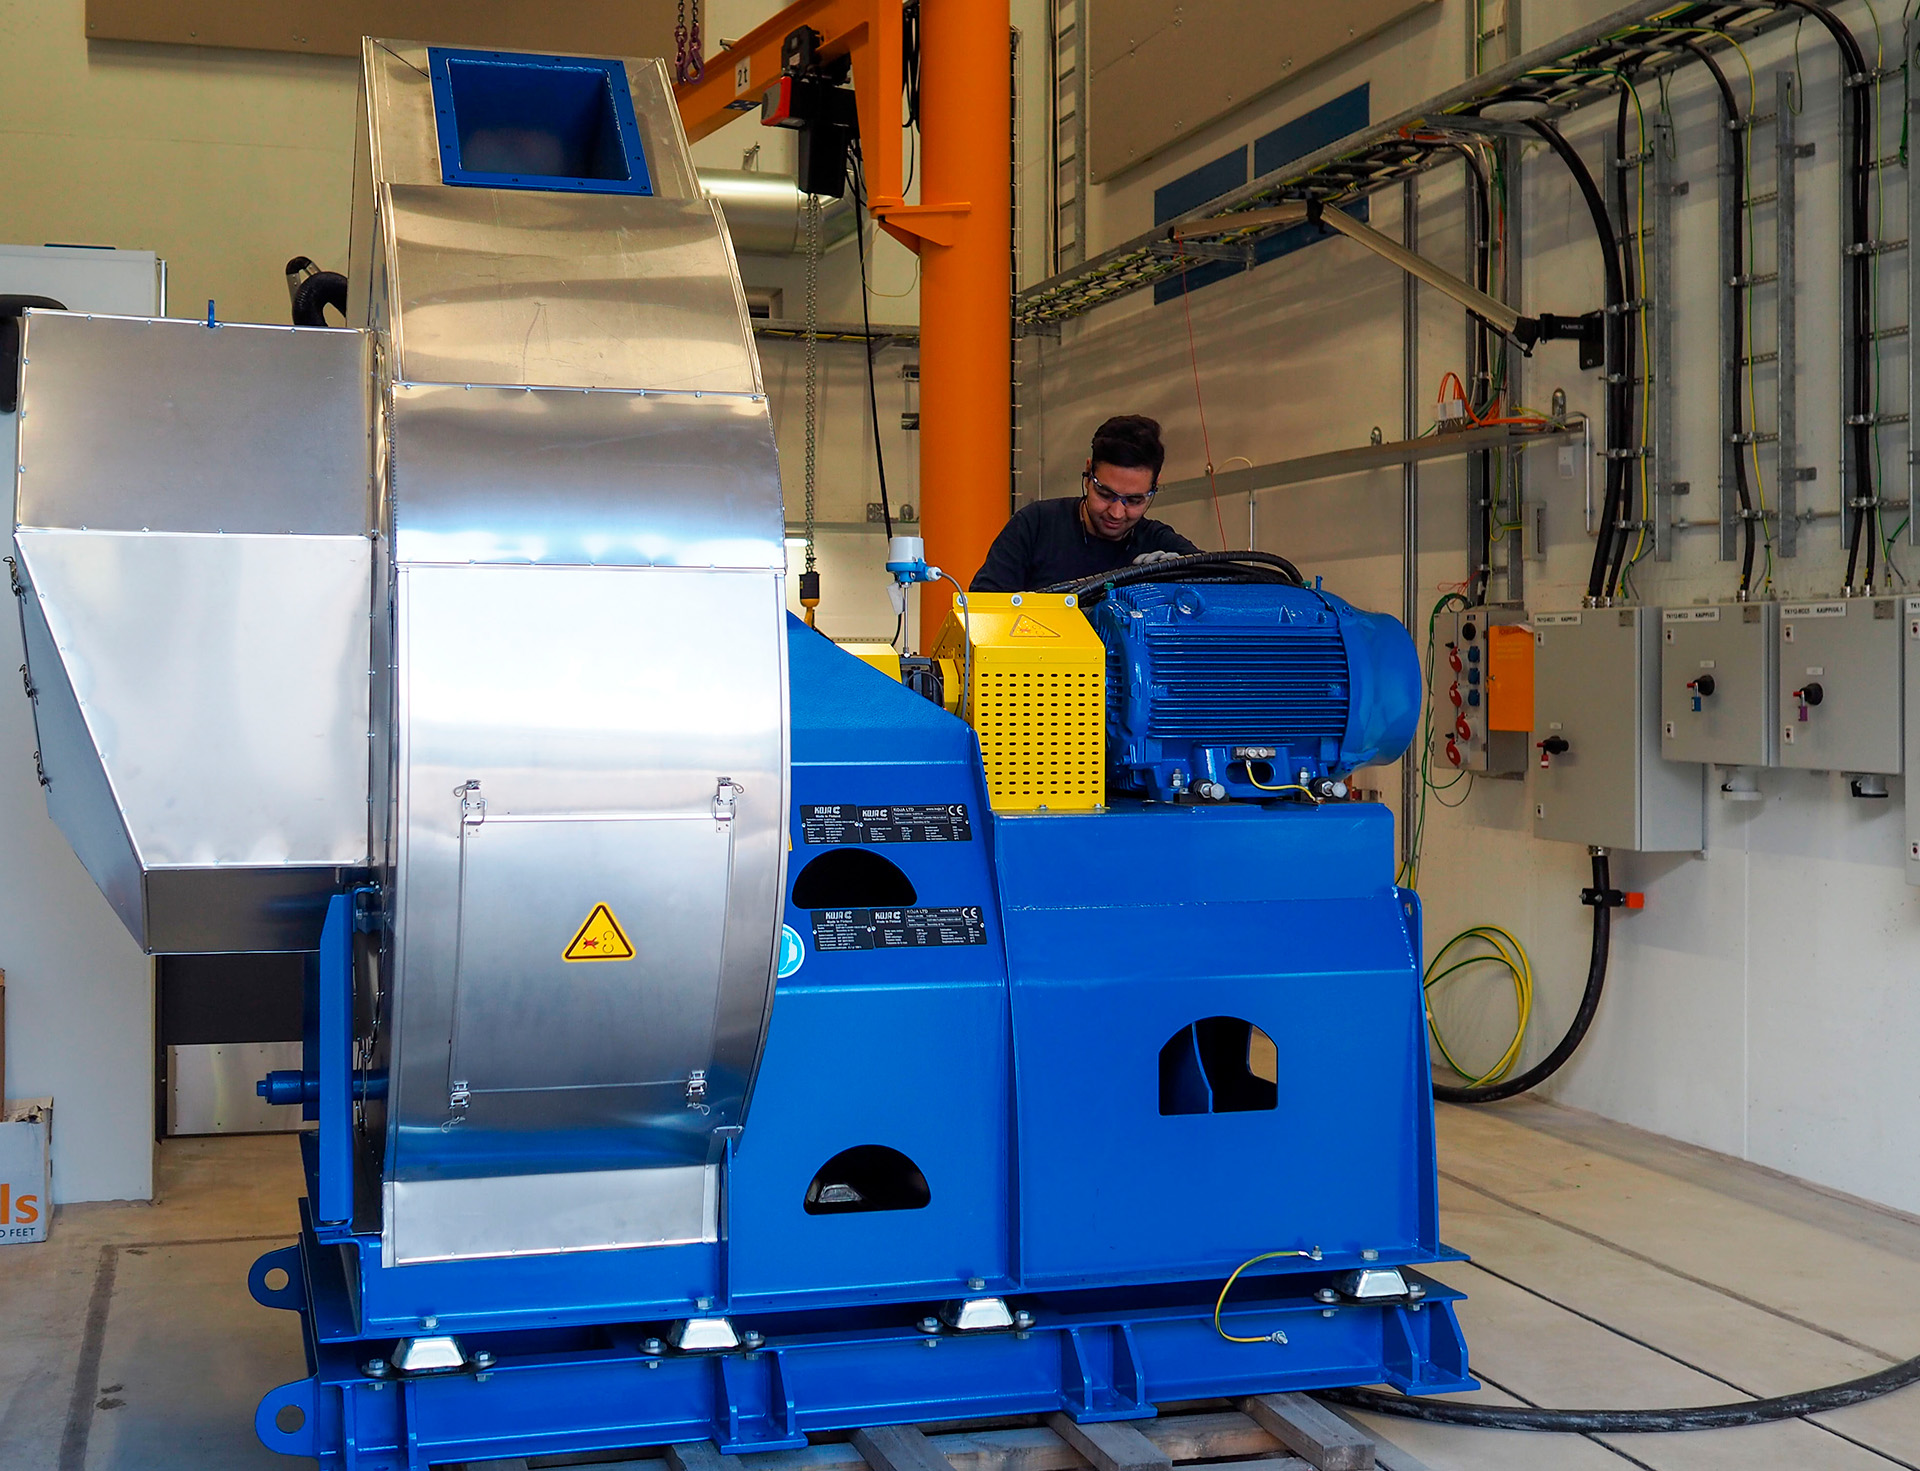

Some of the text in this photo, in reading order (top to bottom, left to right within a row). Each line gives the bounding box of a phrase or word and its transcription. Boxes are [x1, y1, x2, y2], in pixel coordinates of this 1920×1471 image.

[814, 806, 832, 814] KOJA
[862, 809, 880, 817] KOJA
[948, 805, 964, 816] CE
[825, 912, 843, 920] KOJA
[875, 912, 893, 920] KOJA
[962, 907, 978, 918] CE
[10, 1227, 35, 1237] FEET
